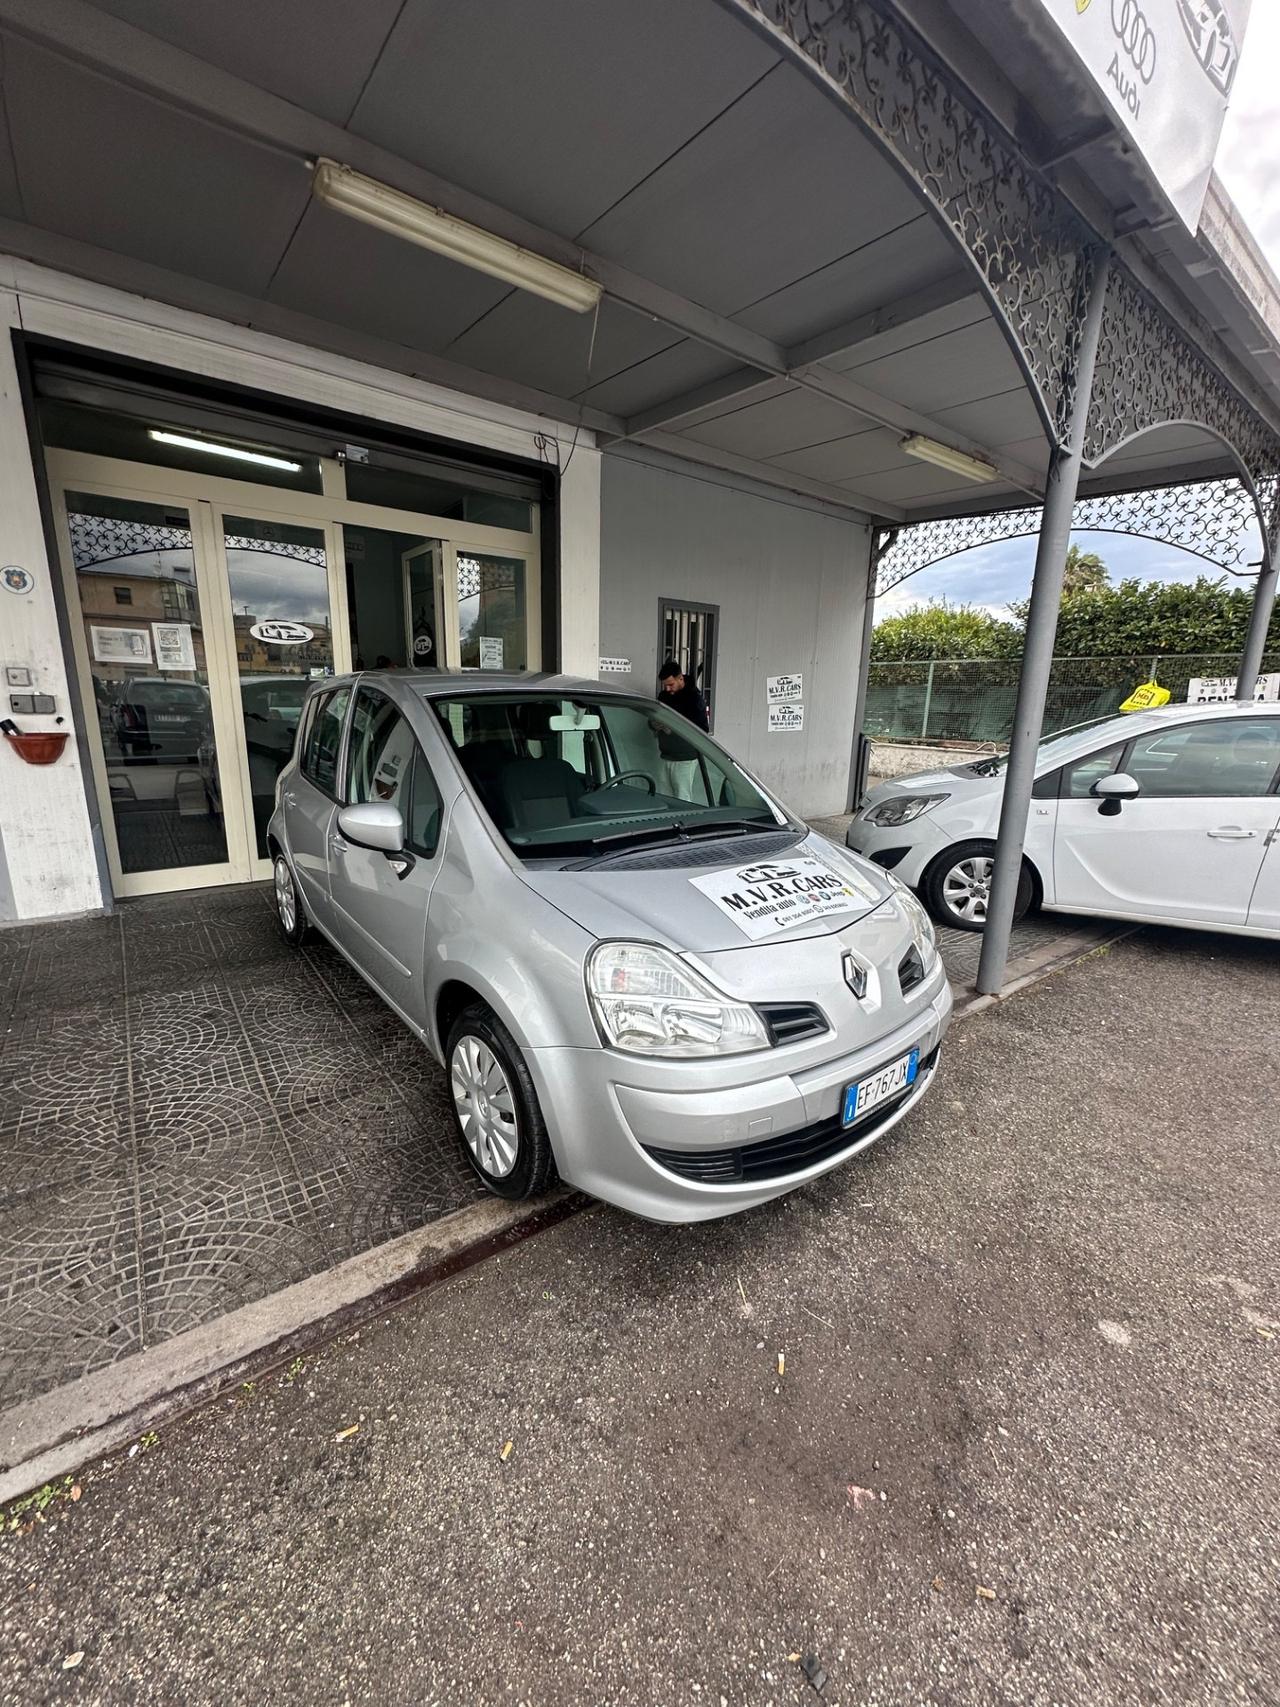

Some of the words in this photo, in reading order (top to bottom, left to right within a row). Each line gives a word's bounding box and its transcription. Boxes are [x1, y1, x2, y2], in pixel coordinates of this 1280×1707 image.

[1106, 52, 1141, 120] Audi
[720, 874, 843, 912] M.V.R.CARS
[743, 903, 779, 920] Vendita
[778, 899, 796, 911] auto
